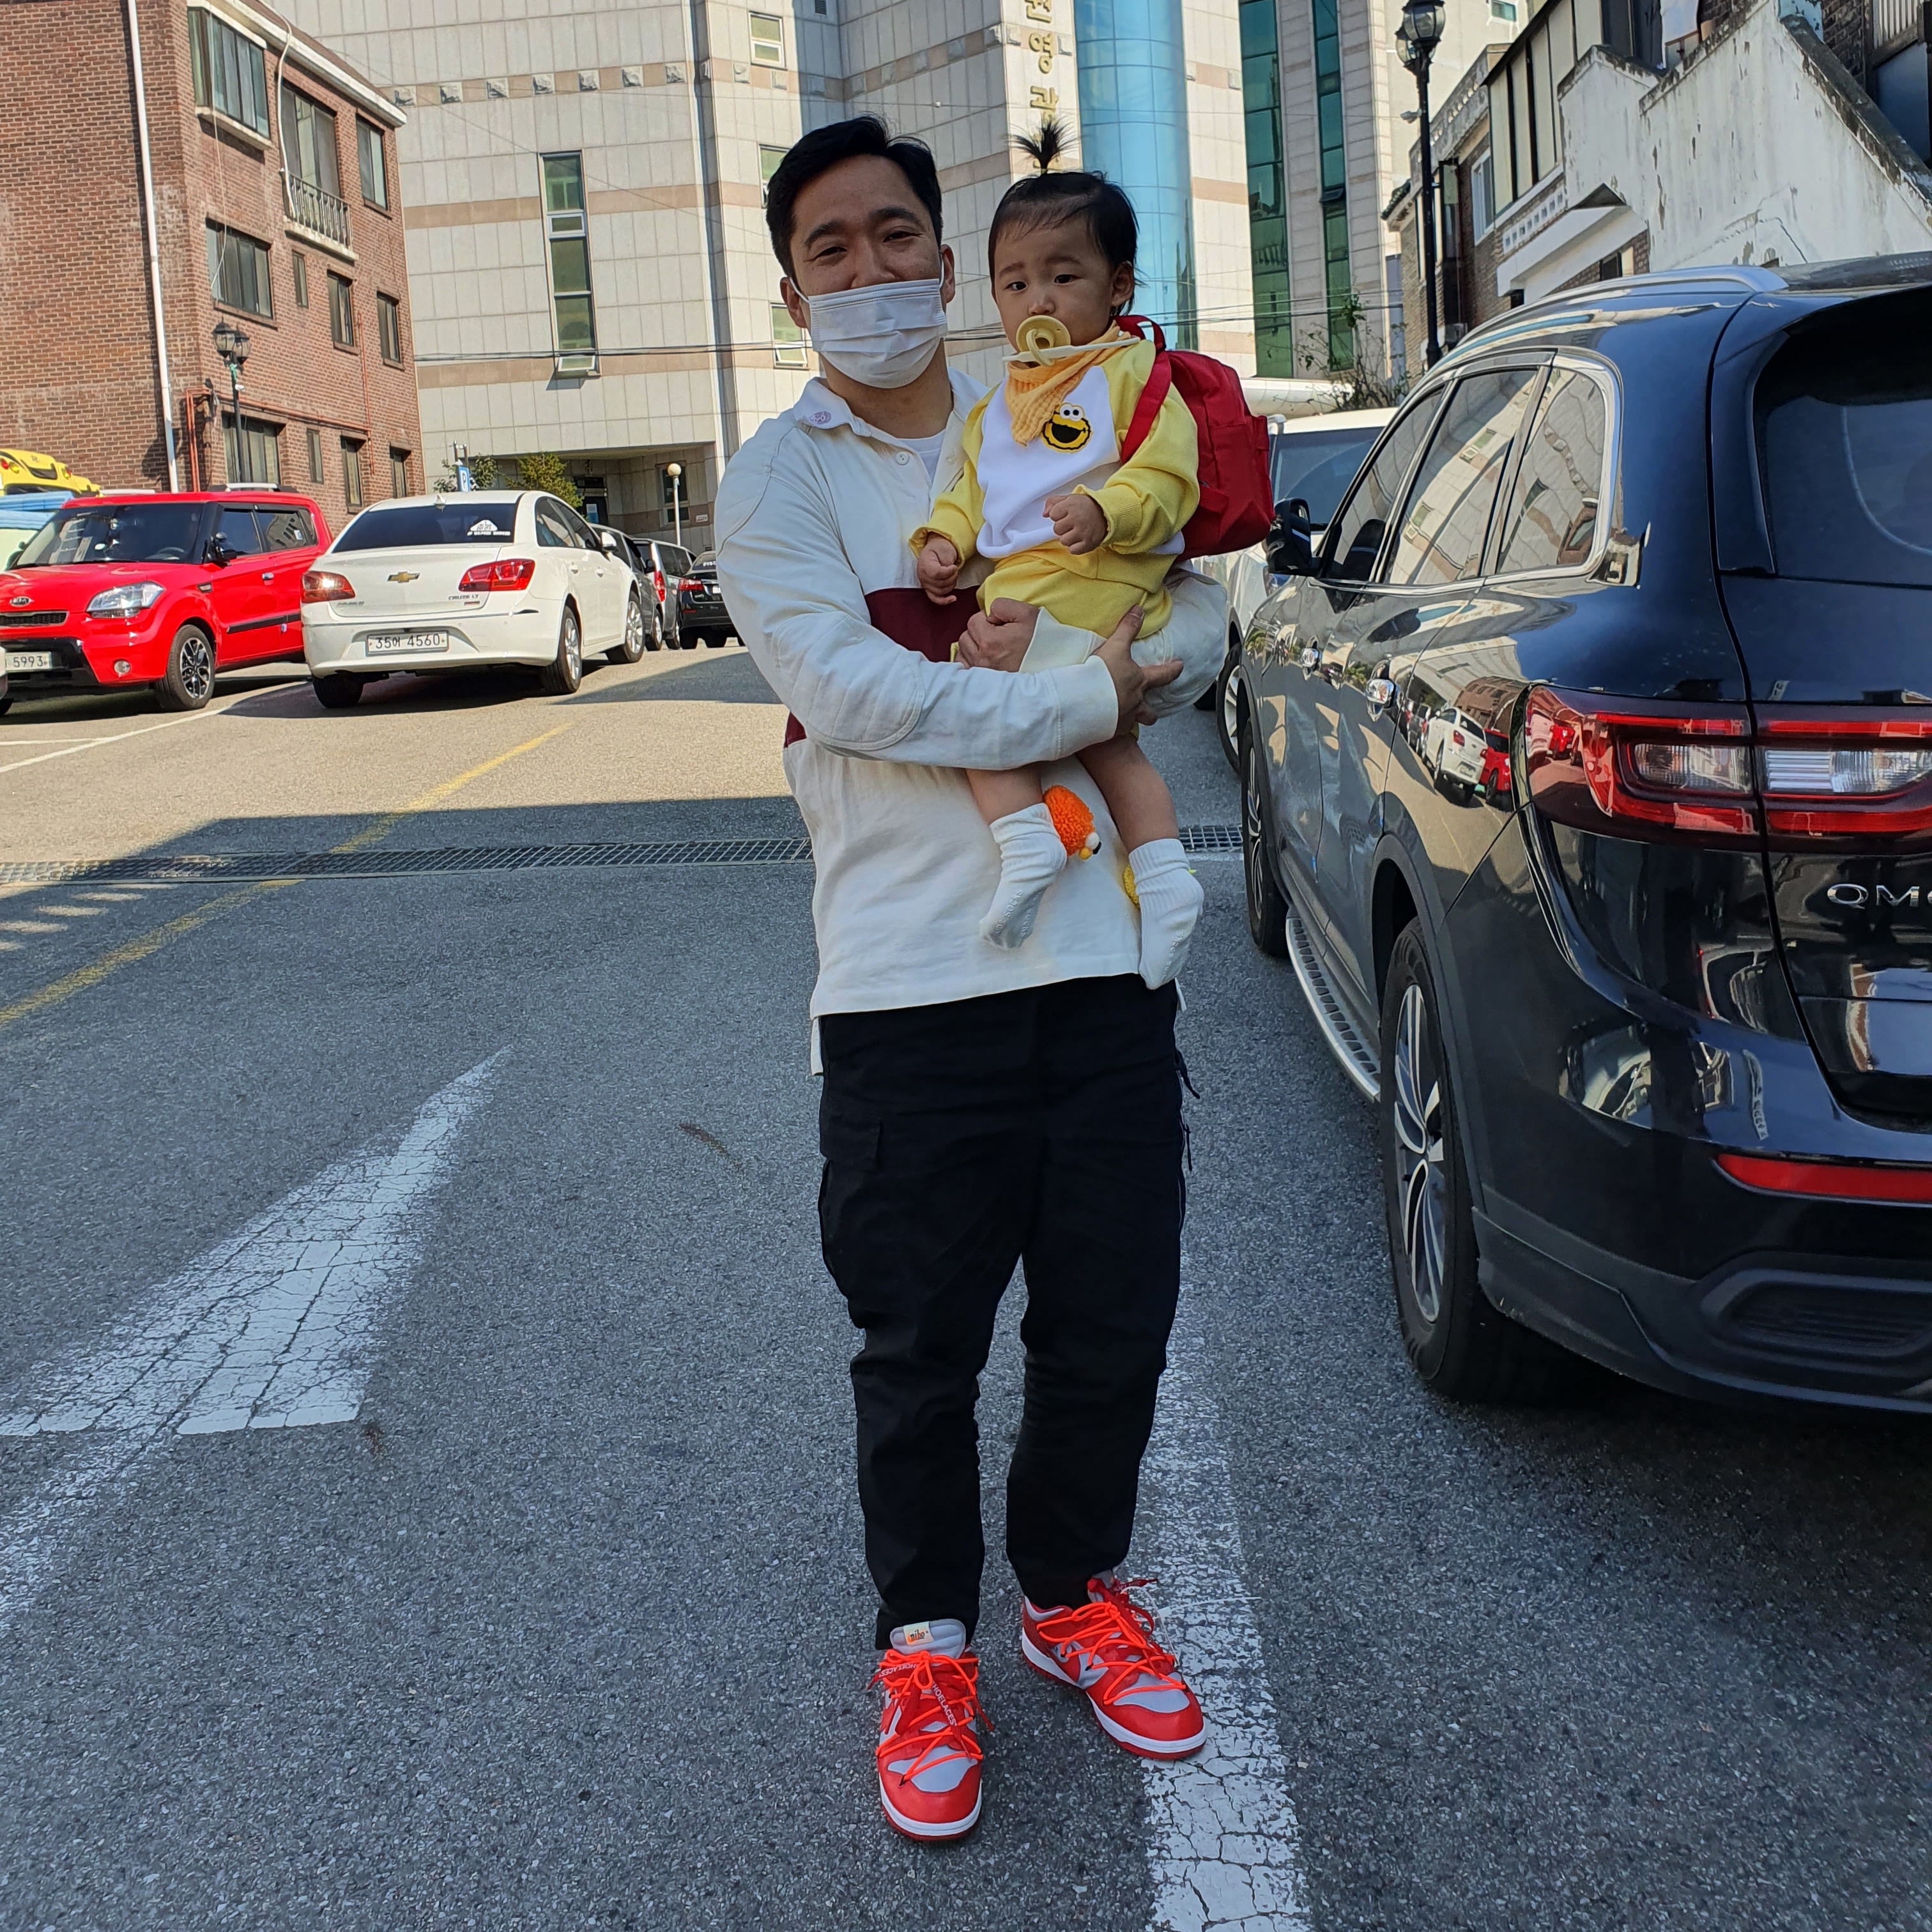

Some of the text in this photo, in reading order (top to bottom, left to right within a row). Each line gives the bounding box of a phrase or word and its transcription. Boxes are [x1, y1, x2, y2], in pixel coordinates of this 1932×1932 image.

[376, 633, 441, 649] 35어 4560
[13, 656, 43, 668] 5993
[1004, 889, 1023, 918] SOCKS
[1827, 884, 1932, 910] QM
